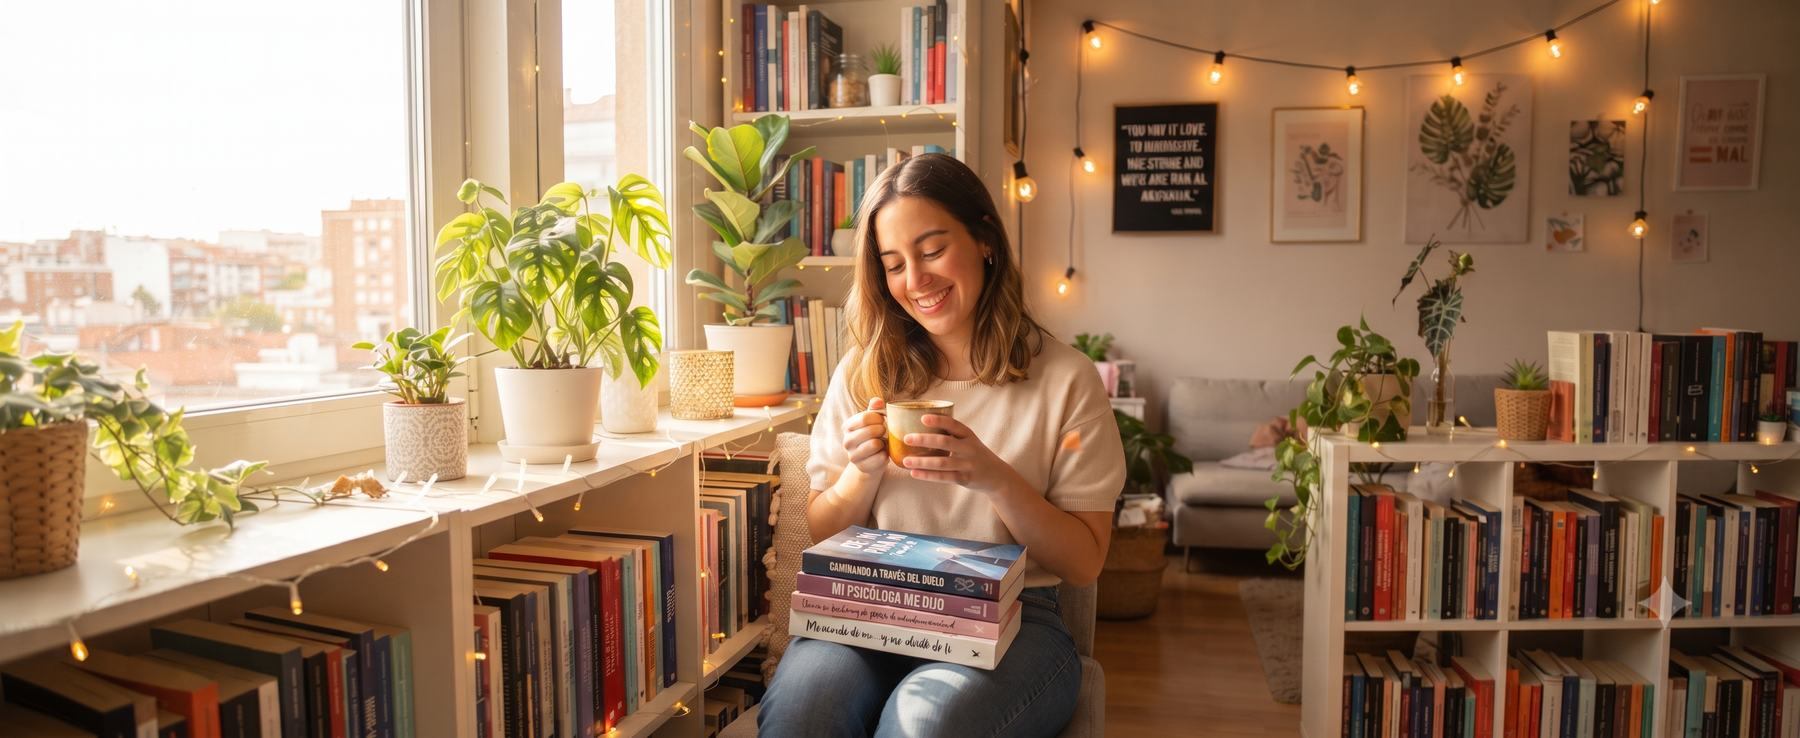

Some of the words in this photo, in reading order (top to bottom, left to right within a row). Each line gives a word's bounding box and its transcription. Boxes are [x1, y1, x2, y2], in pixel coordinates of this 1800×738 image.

[1168, 123, 1179, 136] IT
[1183, 156, 1204, 169] AND
[1716, 145, 1748, 163] MAL
[829, 561, 871, 577] CAMINANDO
[872, 568, 878, 578] A
[879, 568, 906, 582] TRAVÉS
[907, 572, 920, 584] DEL
[922, 574, 945, 587] DUELO
[831, 582, 845, 596] MI
[847, 584, 901, 604] PSICÓLOGA
[903, 592, 920, 608] ME
[922, 595, 945, 611] DIJO
